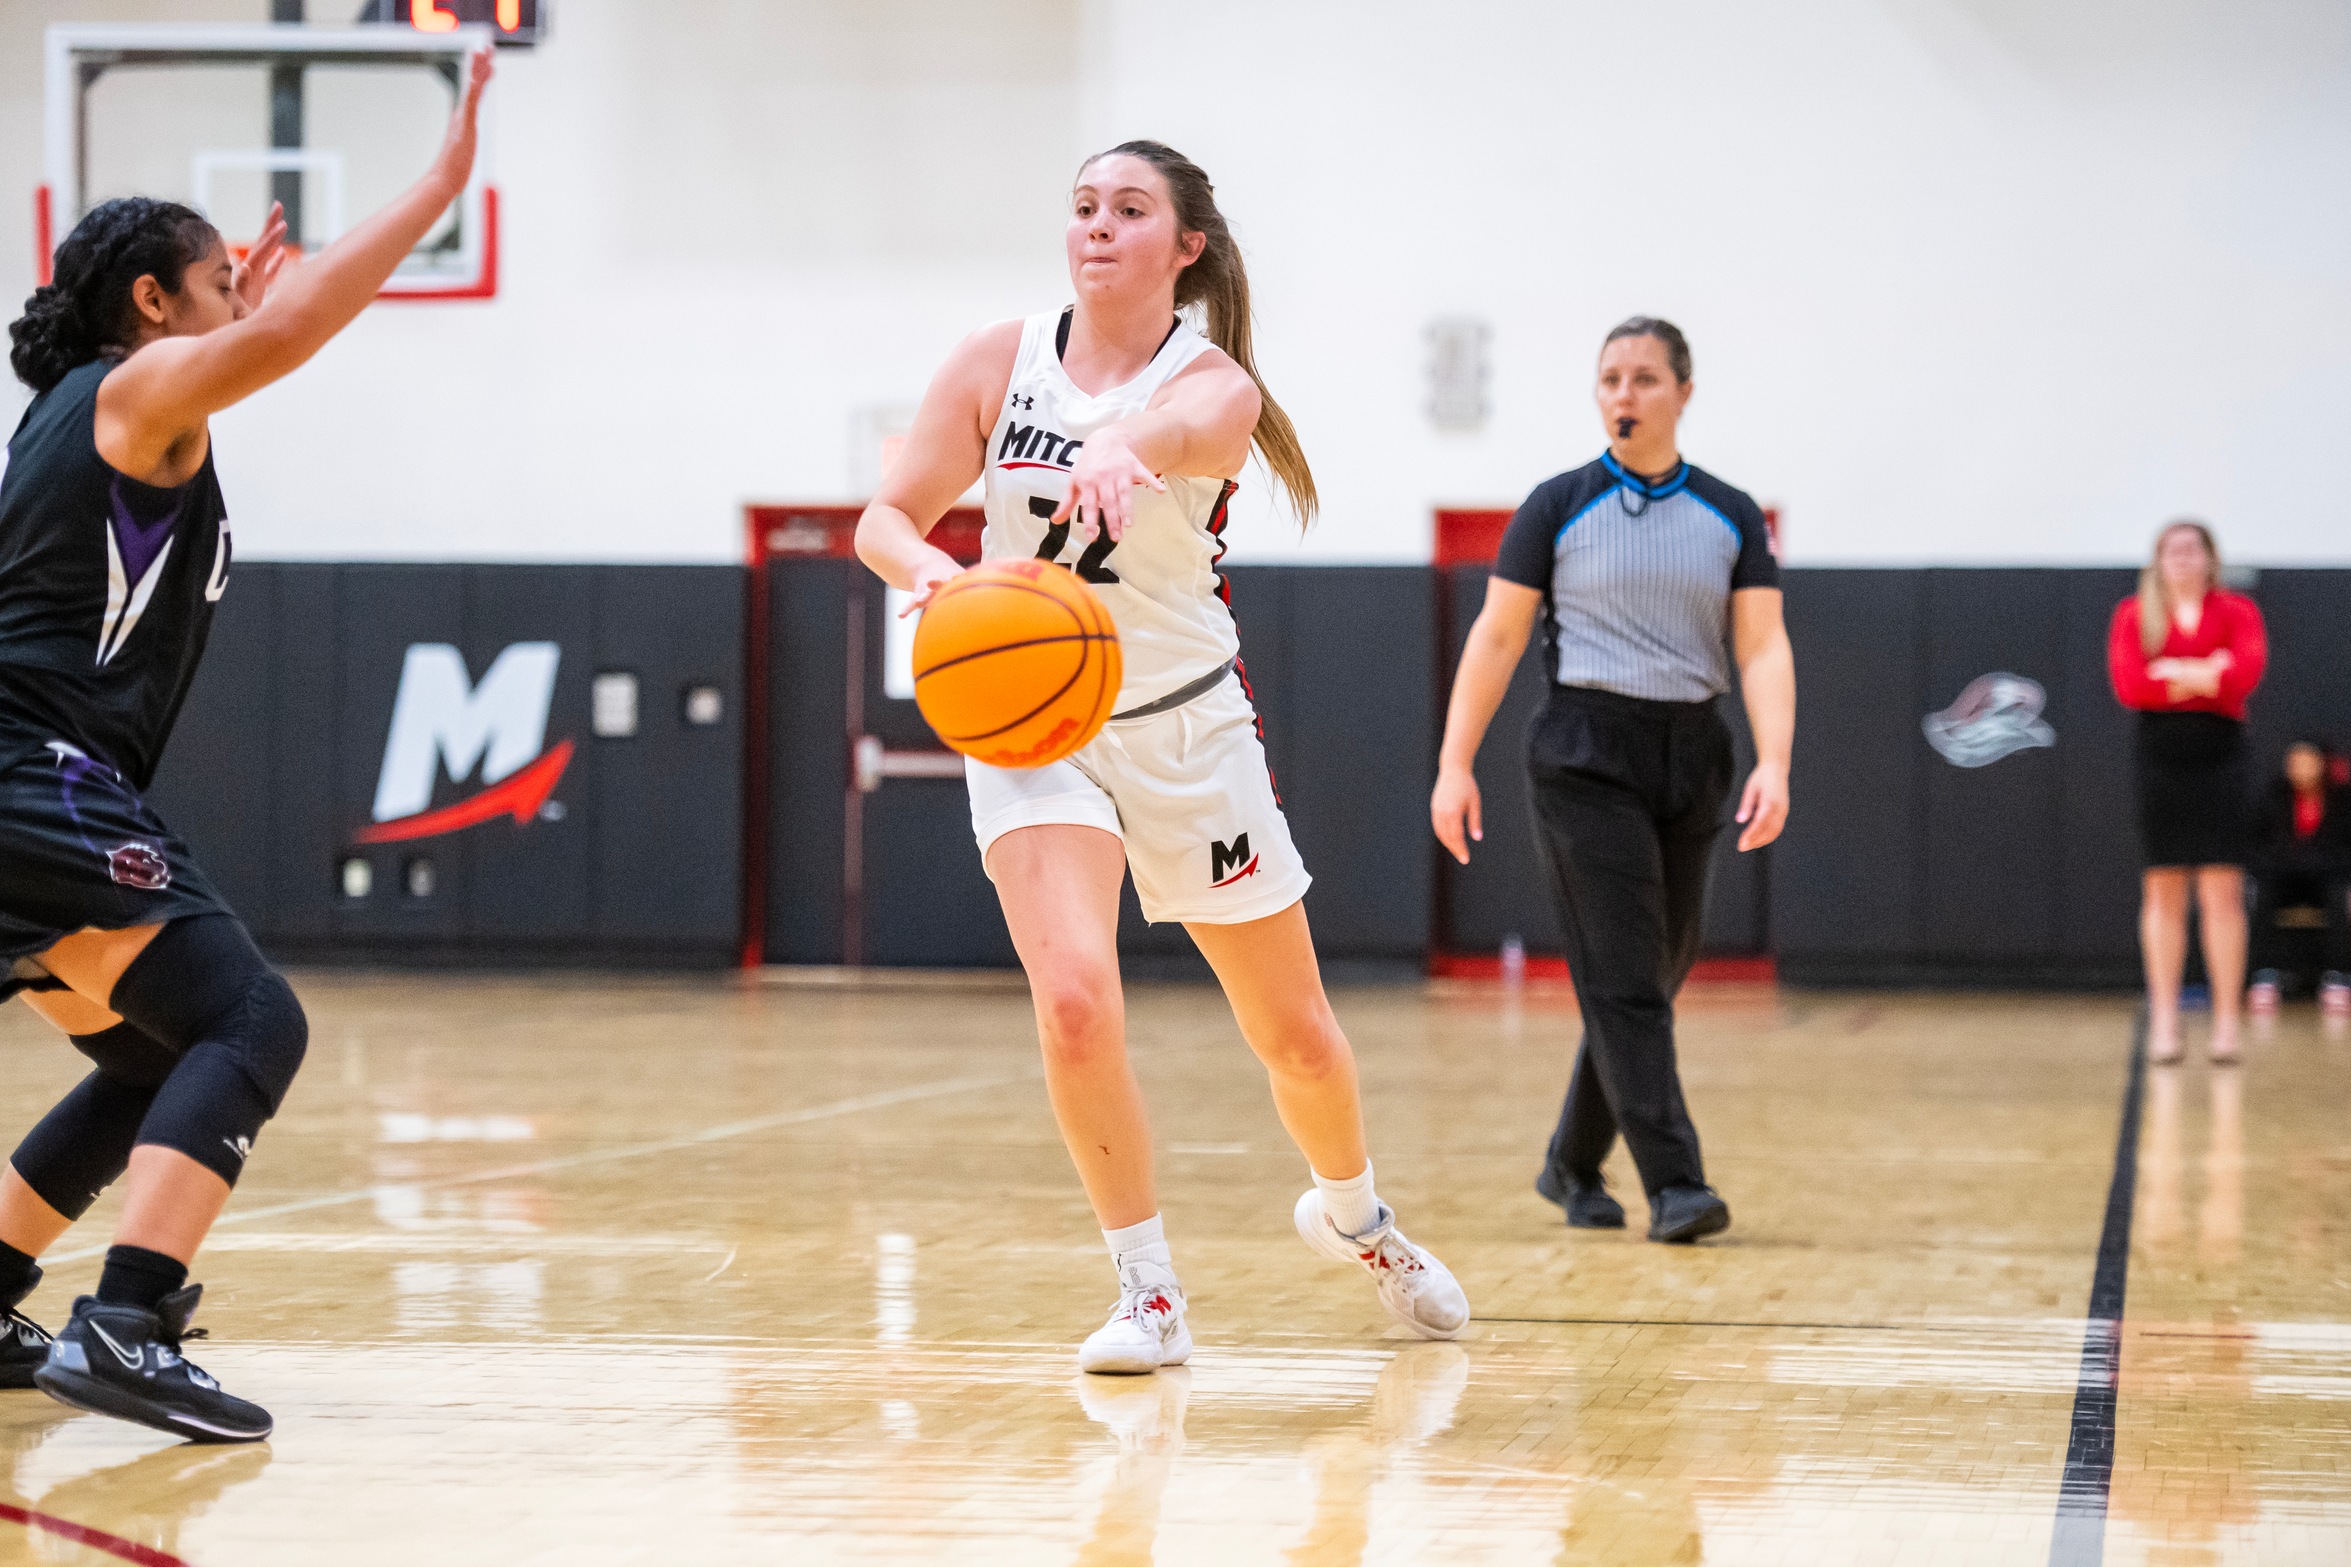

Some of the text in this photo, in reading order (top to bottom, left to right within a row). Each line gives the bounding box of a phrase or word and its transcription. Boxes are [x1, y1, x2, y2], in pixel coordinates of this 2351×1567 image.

[998, 421, 1084, 468] MITC
[373, 641, 560, 823] M
[1210, 831, 1251, 884] M
